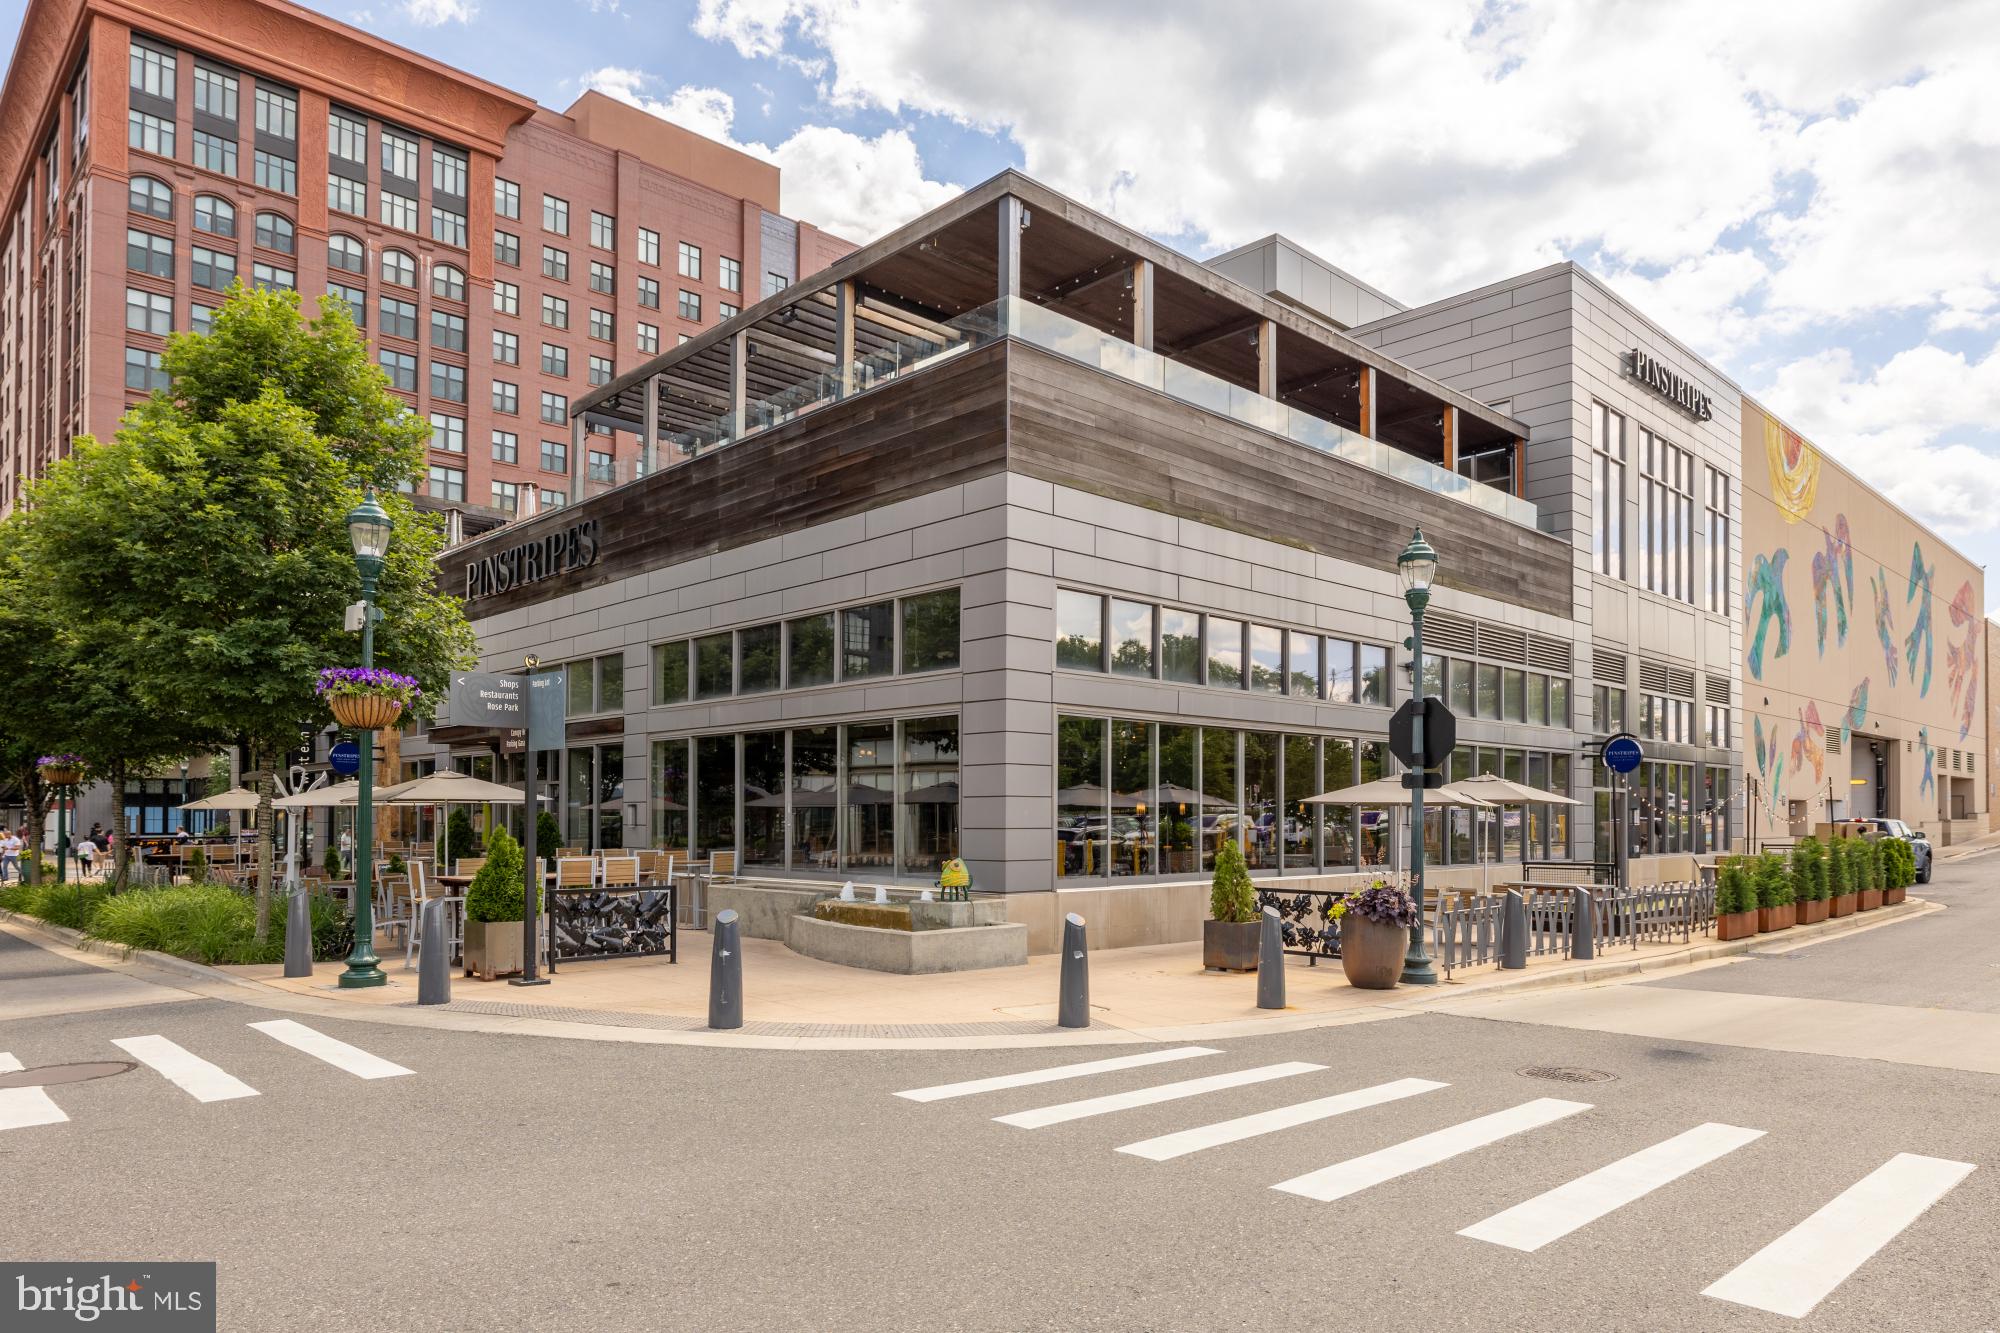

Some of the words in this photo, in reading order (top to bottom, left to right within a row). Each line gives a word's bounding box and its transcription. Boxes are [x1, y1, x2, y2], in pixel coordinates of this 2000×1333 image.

[1632, 348, 1713, 422] PINSTRIPES
[465, 520, 598, 600] PINSTRIPES
[499, 680, 519, 689] Shops
[480, 690, 519, 700] Restaurants
[487, 702, 502, 711] Rose
[504, 703, 519, 712] Park
